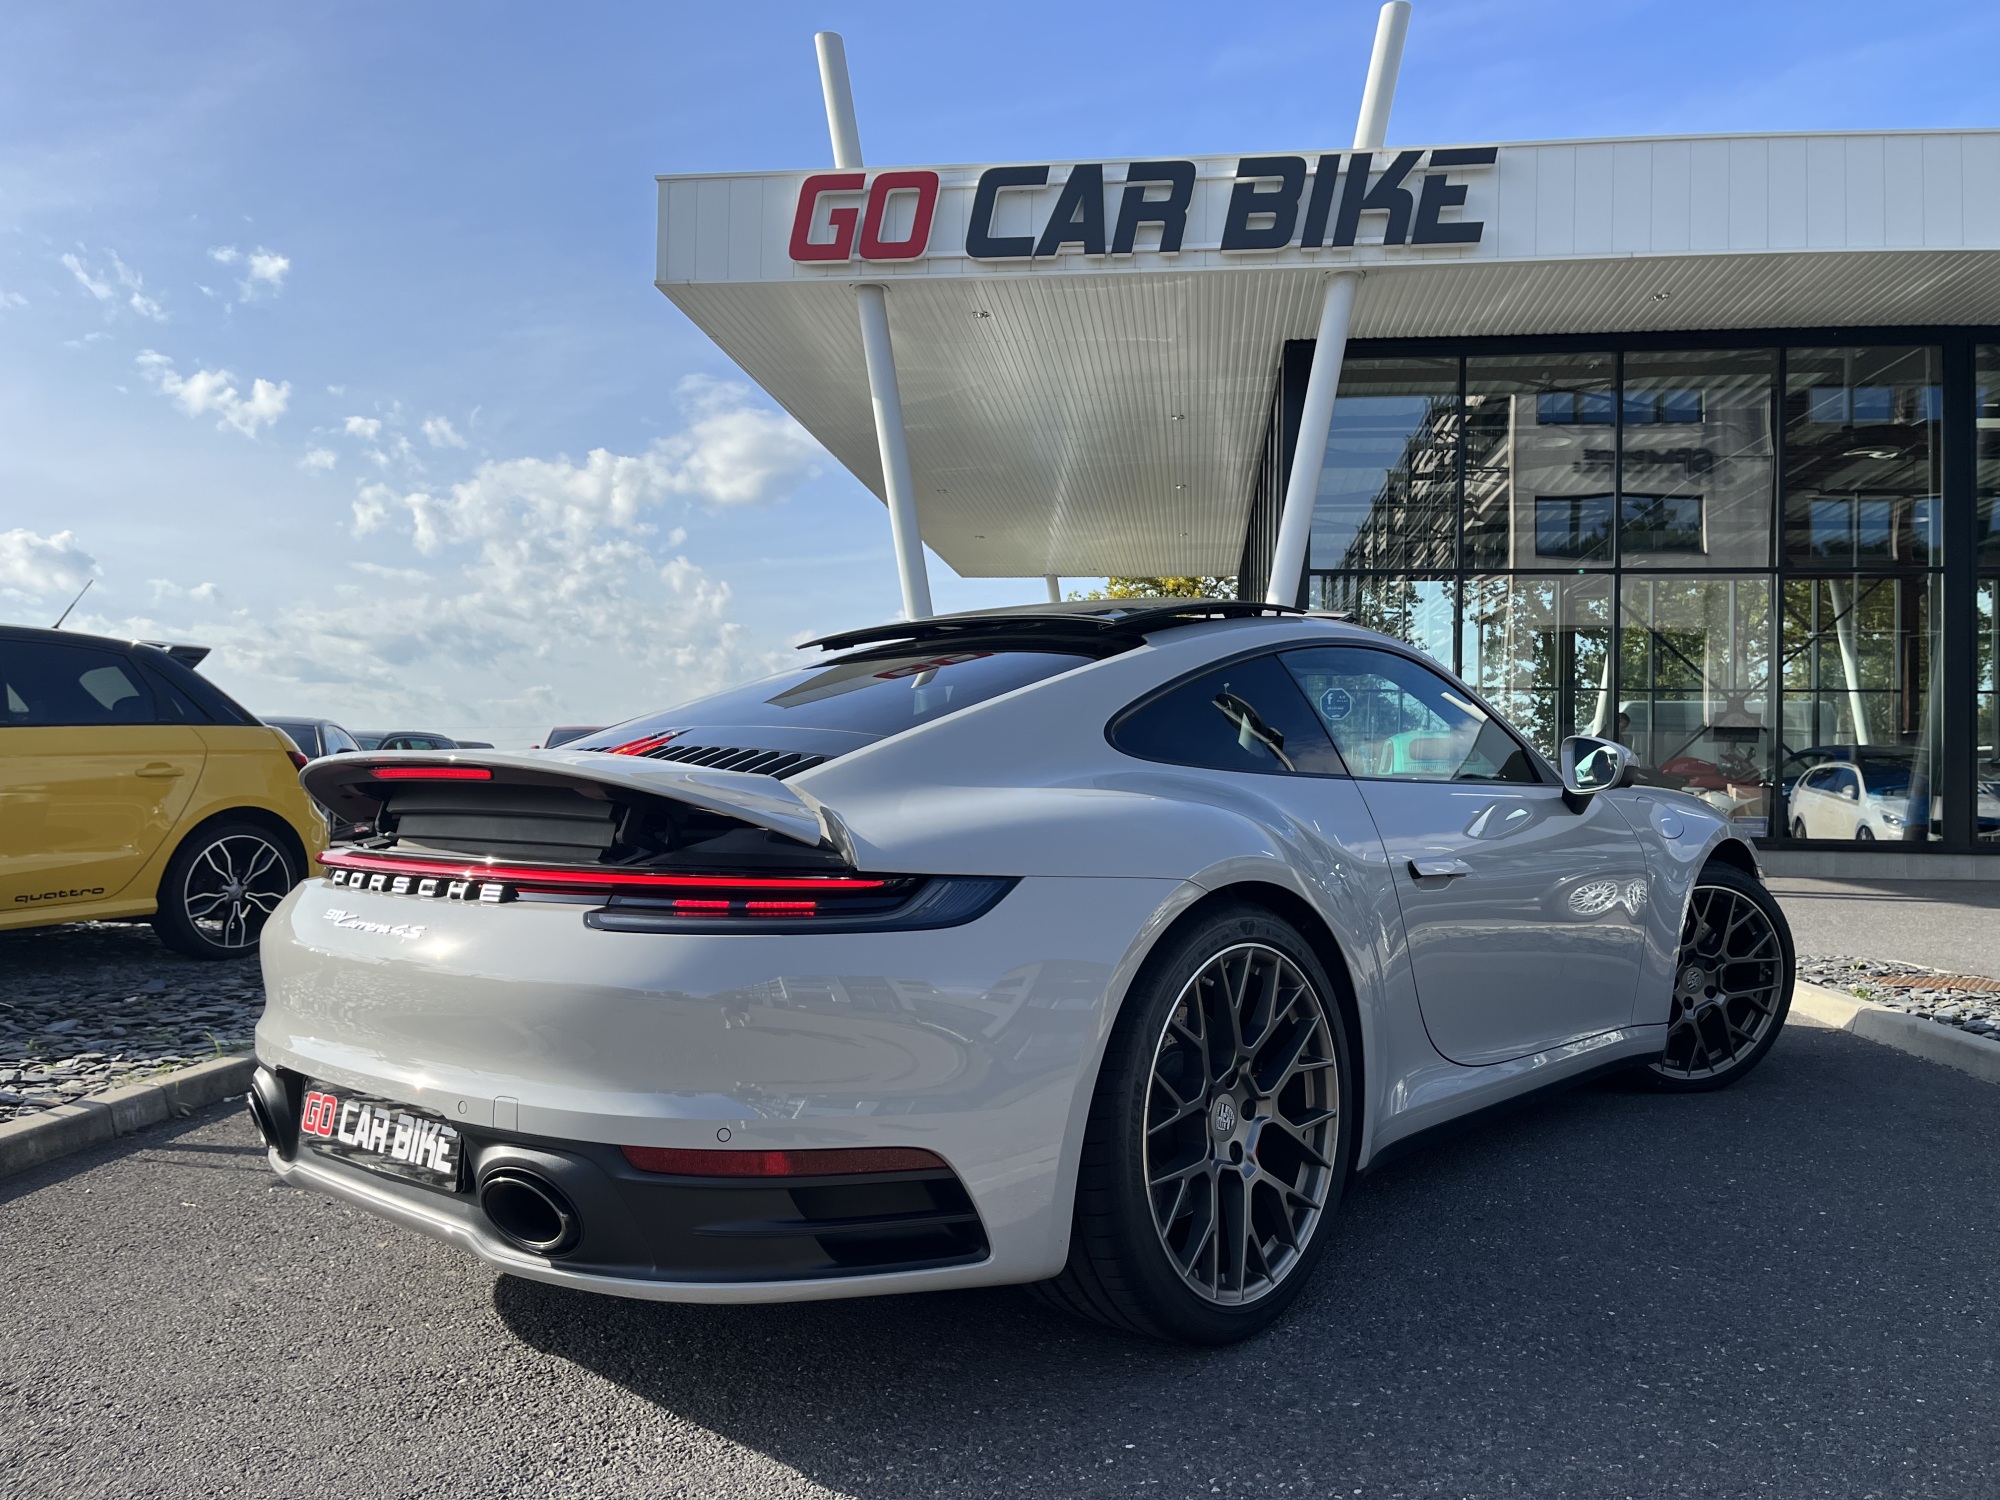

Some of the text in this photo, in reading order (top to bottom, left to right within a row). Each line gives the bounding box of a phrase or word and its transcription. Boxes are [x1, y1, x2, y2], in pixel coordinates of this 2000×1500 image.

[788, 146, 1498, 263] GO CAR BIKE
[14, 887, 105, 903] quattro
[331, 869, 505, 903] PORSCHE
[334, 914, 392, 934] Carrera
[301, 1090, 458, 1174] GO CAR BIKE
